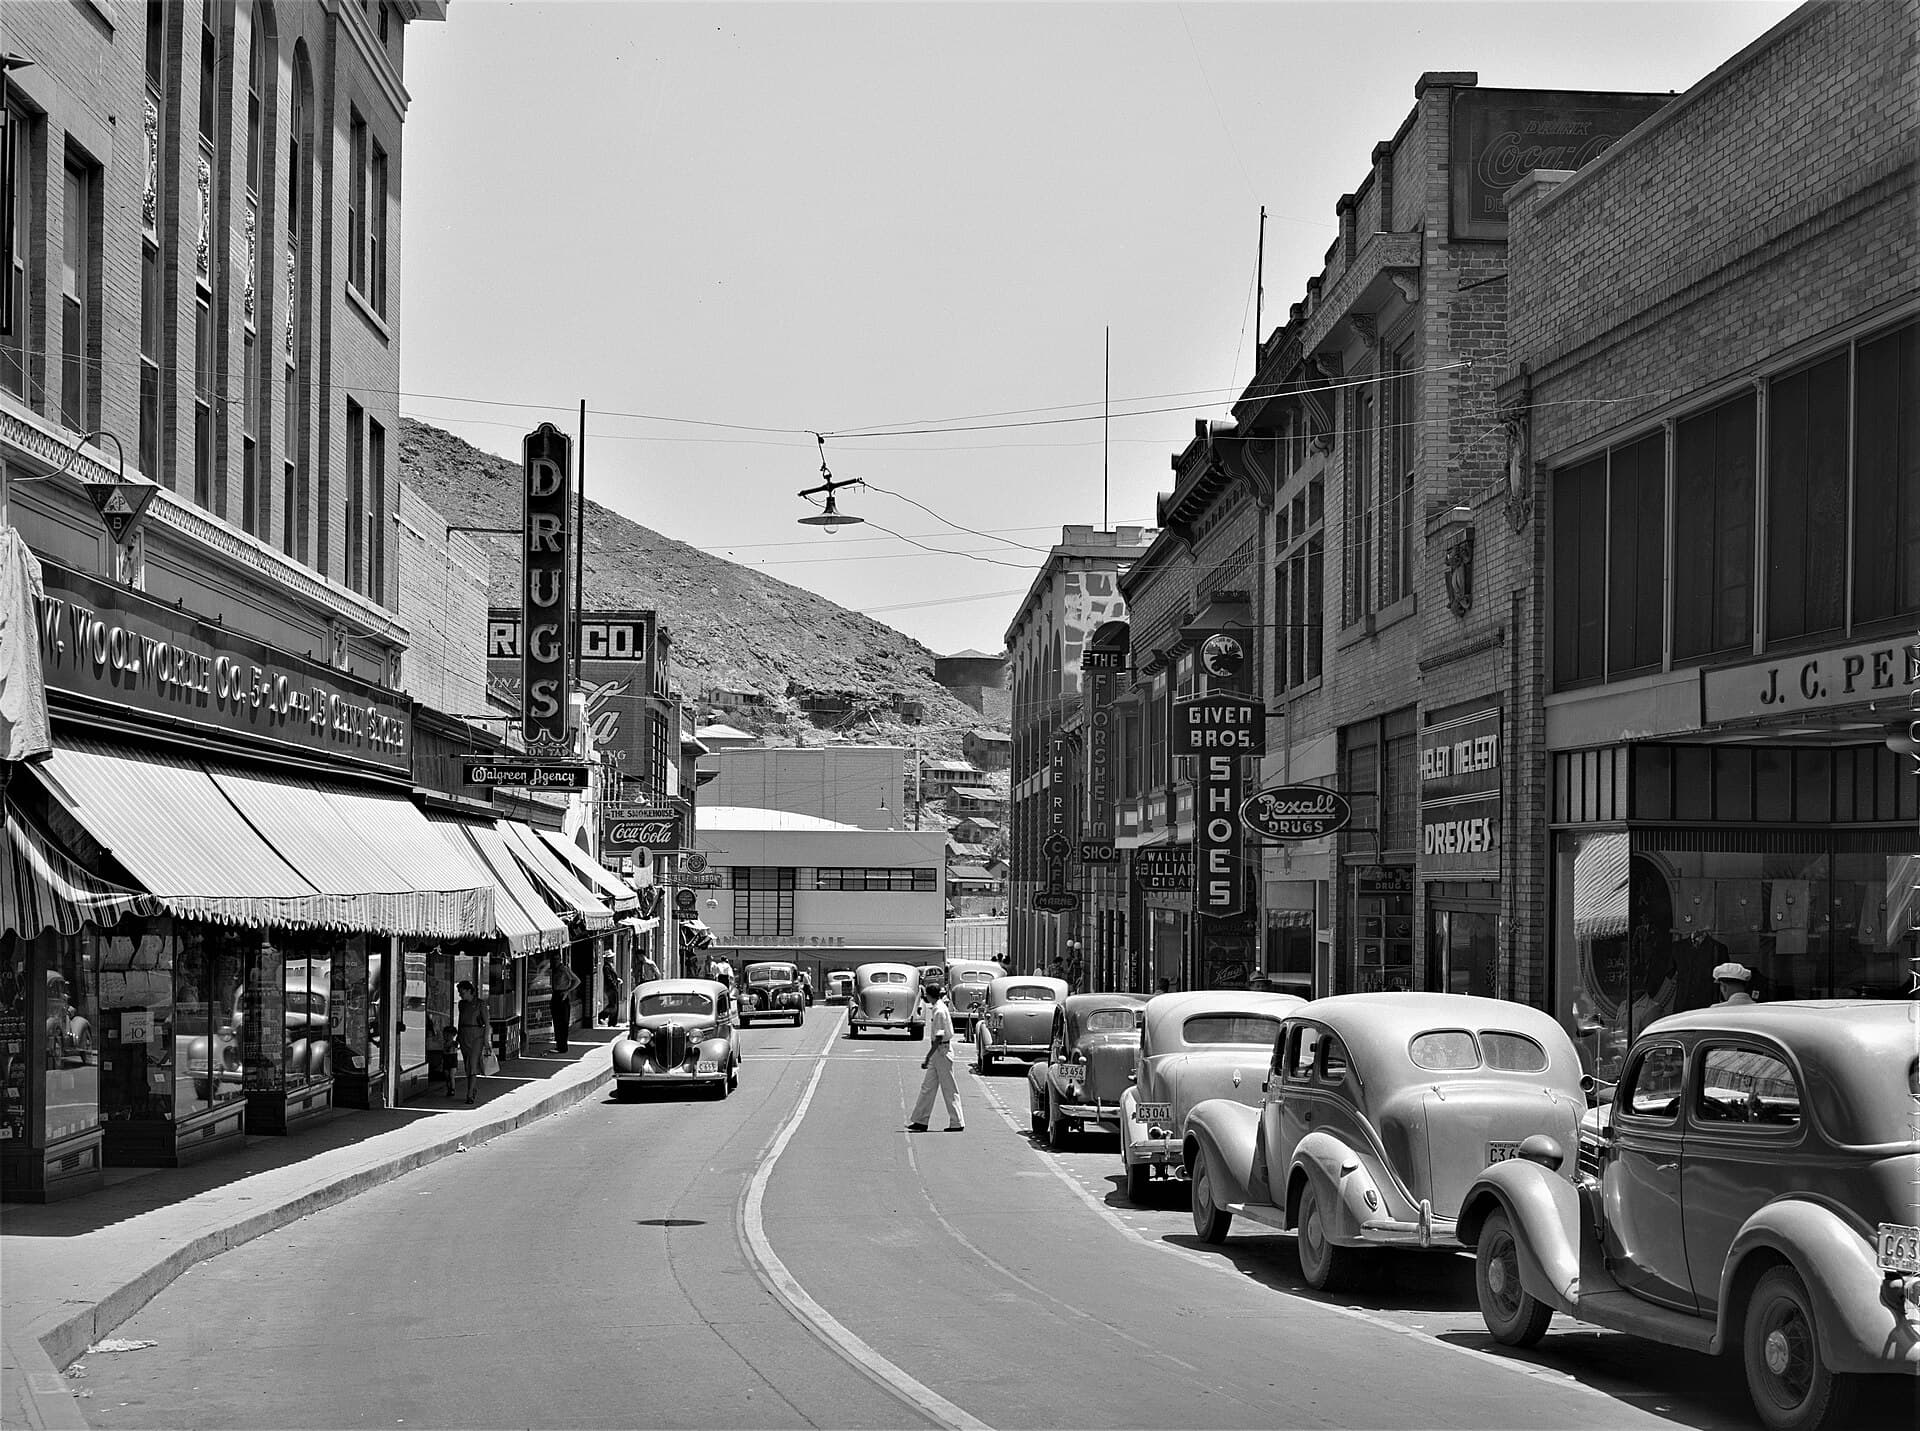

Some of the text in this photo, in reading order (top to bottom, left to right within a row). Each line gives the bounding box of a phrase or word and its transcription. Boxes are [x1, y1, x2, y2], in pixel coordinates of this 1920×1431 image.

[529, 457, 563, 718] DRUGS
[581, 624, 642, 658] CO.
[70, 603, 211, 695] WOOLWORTH
[310, 687, 327, 727] 15
[1760, 668, 1785, 705] J.
[1800, 659, 1827, 700] C.
[1188, 706, 1253, 725] GIVEN
[1093, 674, 1109, 838] FLORSHEIM
[1190, 730, 1255, 748] BROS.
[471, 766, 575, 787] Walgreen Agency
[1054, 739, 1064, 834] THE RE
[1259, 794, 1337, 817] Rexall
[610, 822, 674, 843] Coca-Cola
[1208, 755, 1233, 906] SHOES
[1268, 820, 1325, 834] DRUGS
[1424, 817, 1491, 855] DRESSES
[1052, 841, 1062, 896] CAFE
[1375, 882, 1401, 890] DRUG
[1139, 1107, 1170, 1119] C3 041
